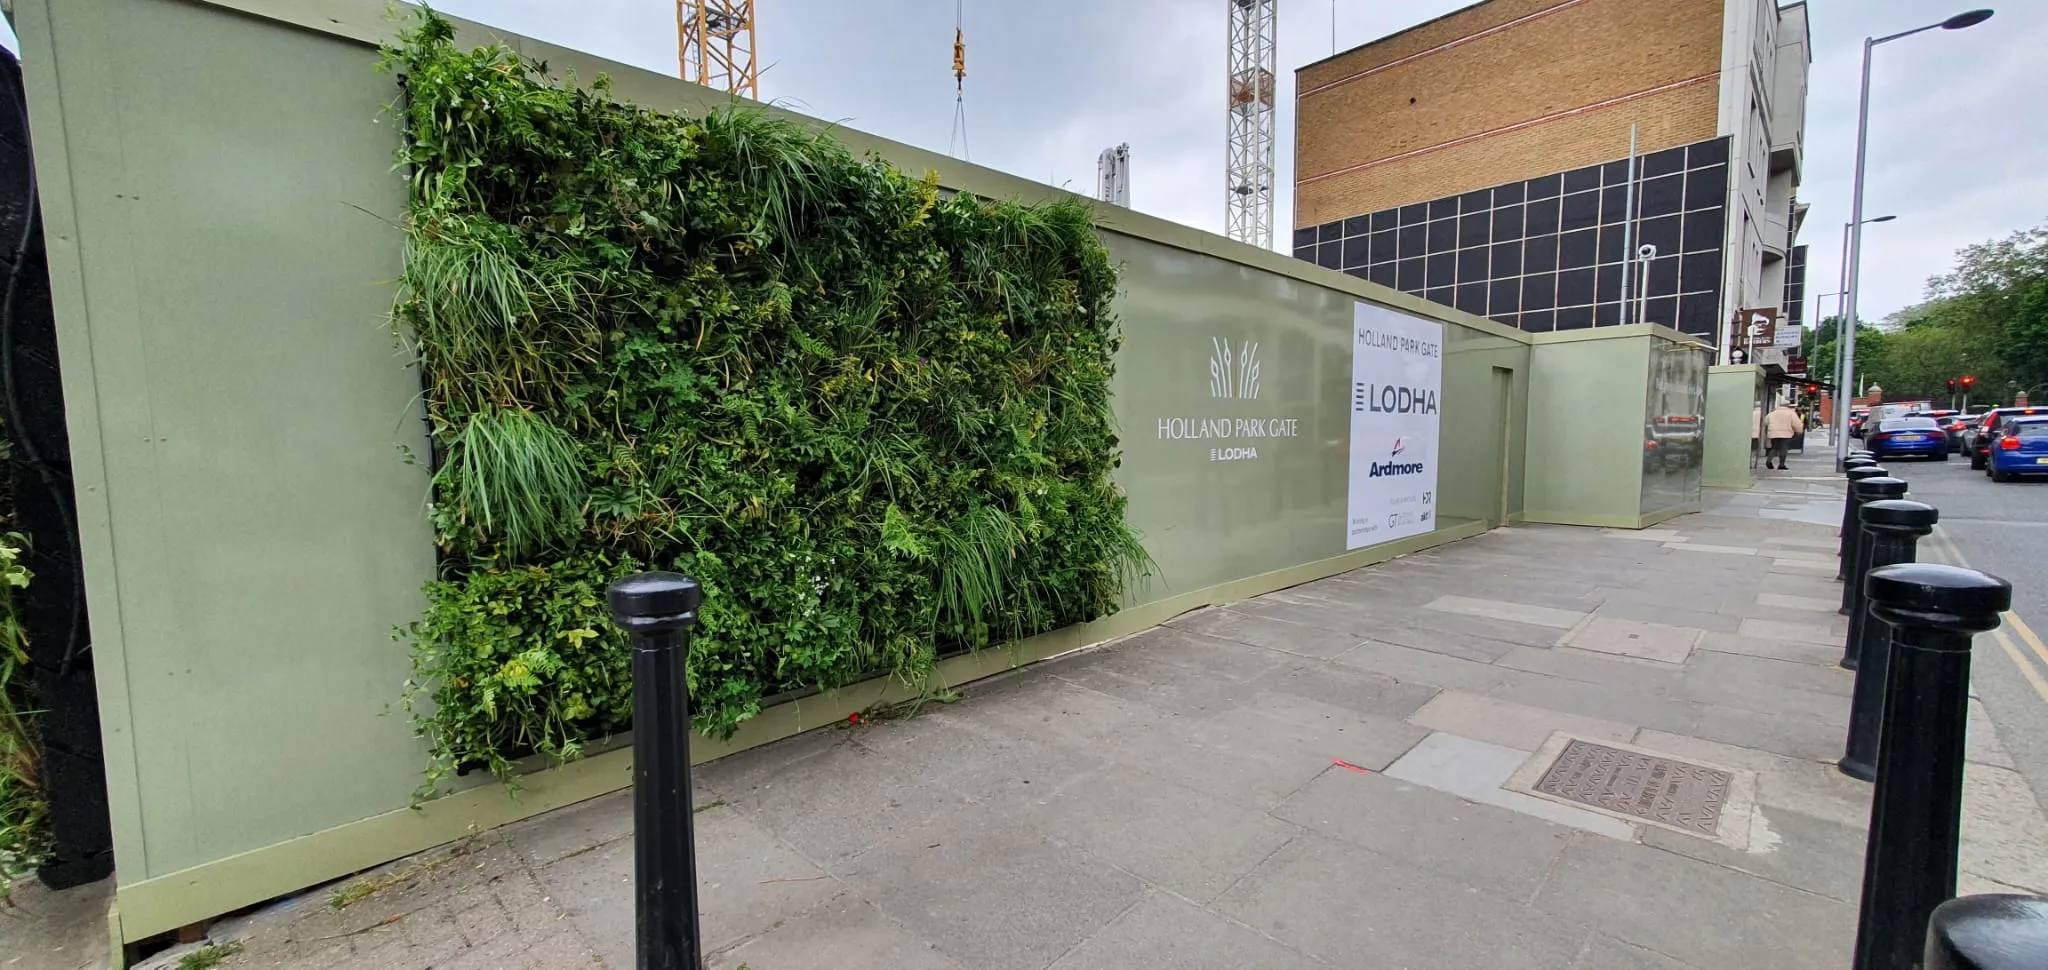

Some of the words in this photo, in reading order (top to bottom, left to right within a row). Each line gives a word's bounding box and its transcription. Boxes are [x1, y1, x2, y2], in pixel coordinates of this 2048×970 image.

[1359, 328, 1398, 351] HOLLAND
[1400, 337, 1420, 355] PARK
[1421, 342, 1438, 358] GATE
[1370, 384, 1437, 415] LODHA
[1158, 417, 1232, 439] HOLLAND
[1235, 419, 1266, 437] PARK
[1269, 419, 1299, 437] GATE
[1218, 447, 1258, 460] LODHA
[1369, 461, 1423, 478] Ardmore
